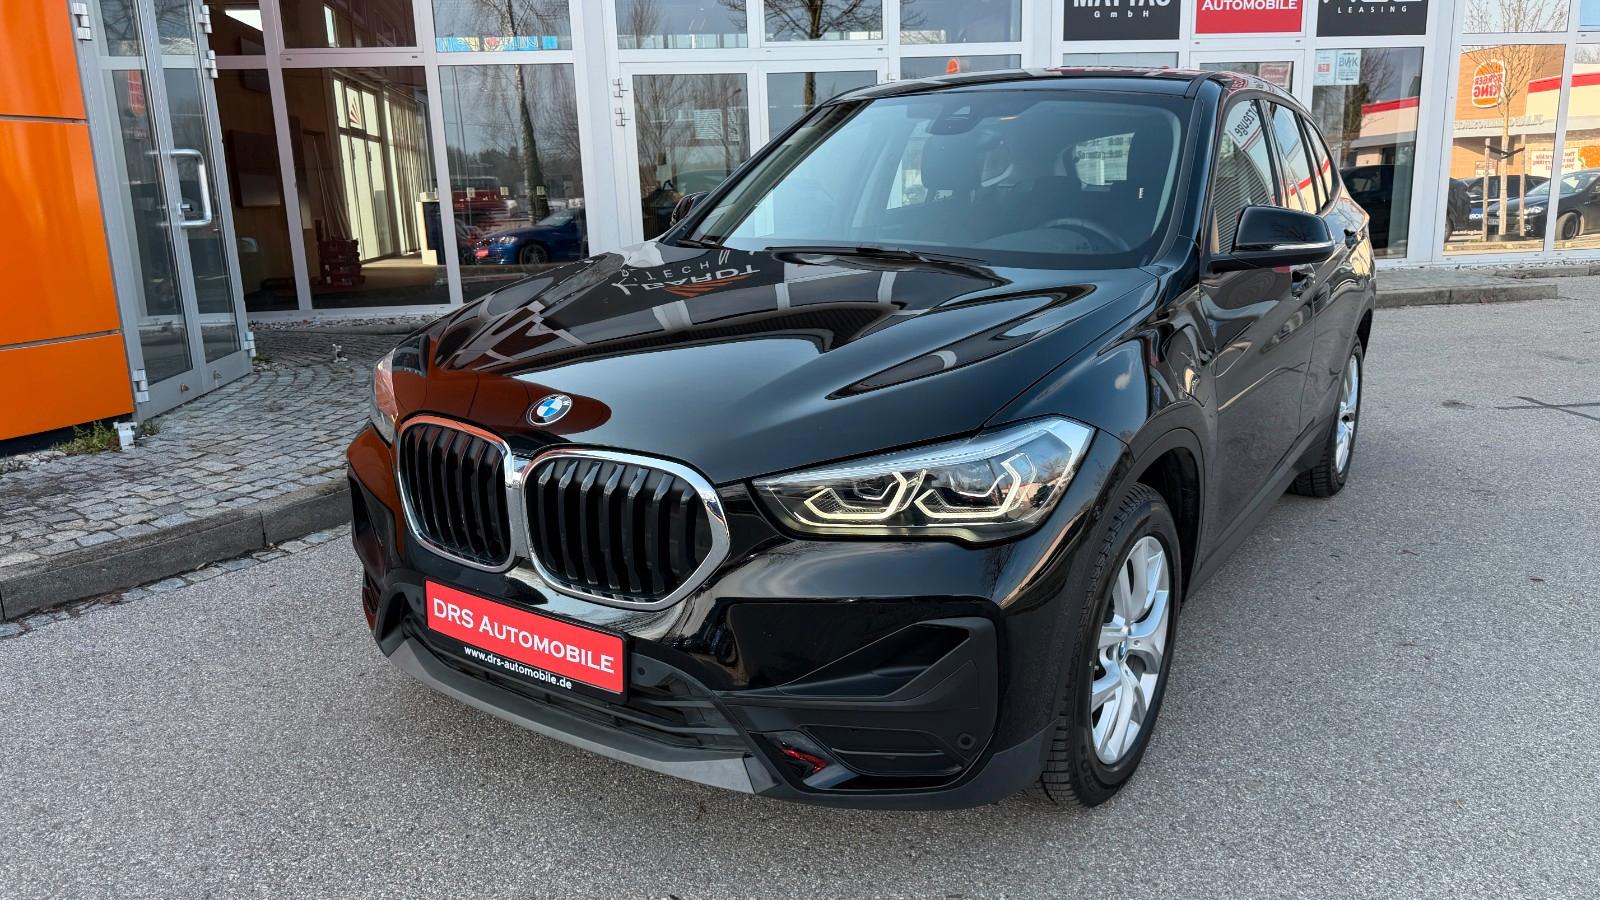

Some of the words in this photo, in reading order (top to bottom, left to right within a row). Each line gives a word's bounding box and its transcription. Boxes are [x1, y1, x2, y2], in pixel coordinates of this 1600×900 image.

[1201, 0, 1298, 11] AUTOMOBILE
[1337, 5, 1408, 14] LEASING
[1093, 10, 1150, 18] GmbH
[433, 597, 474, 629] DRS
[478, 615, 615, 674] AUTOMOBILE
[464, 646, 573, 690] www.drs-automobile.de
